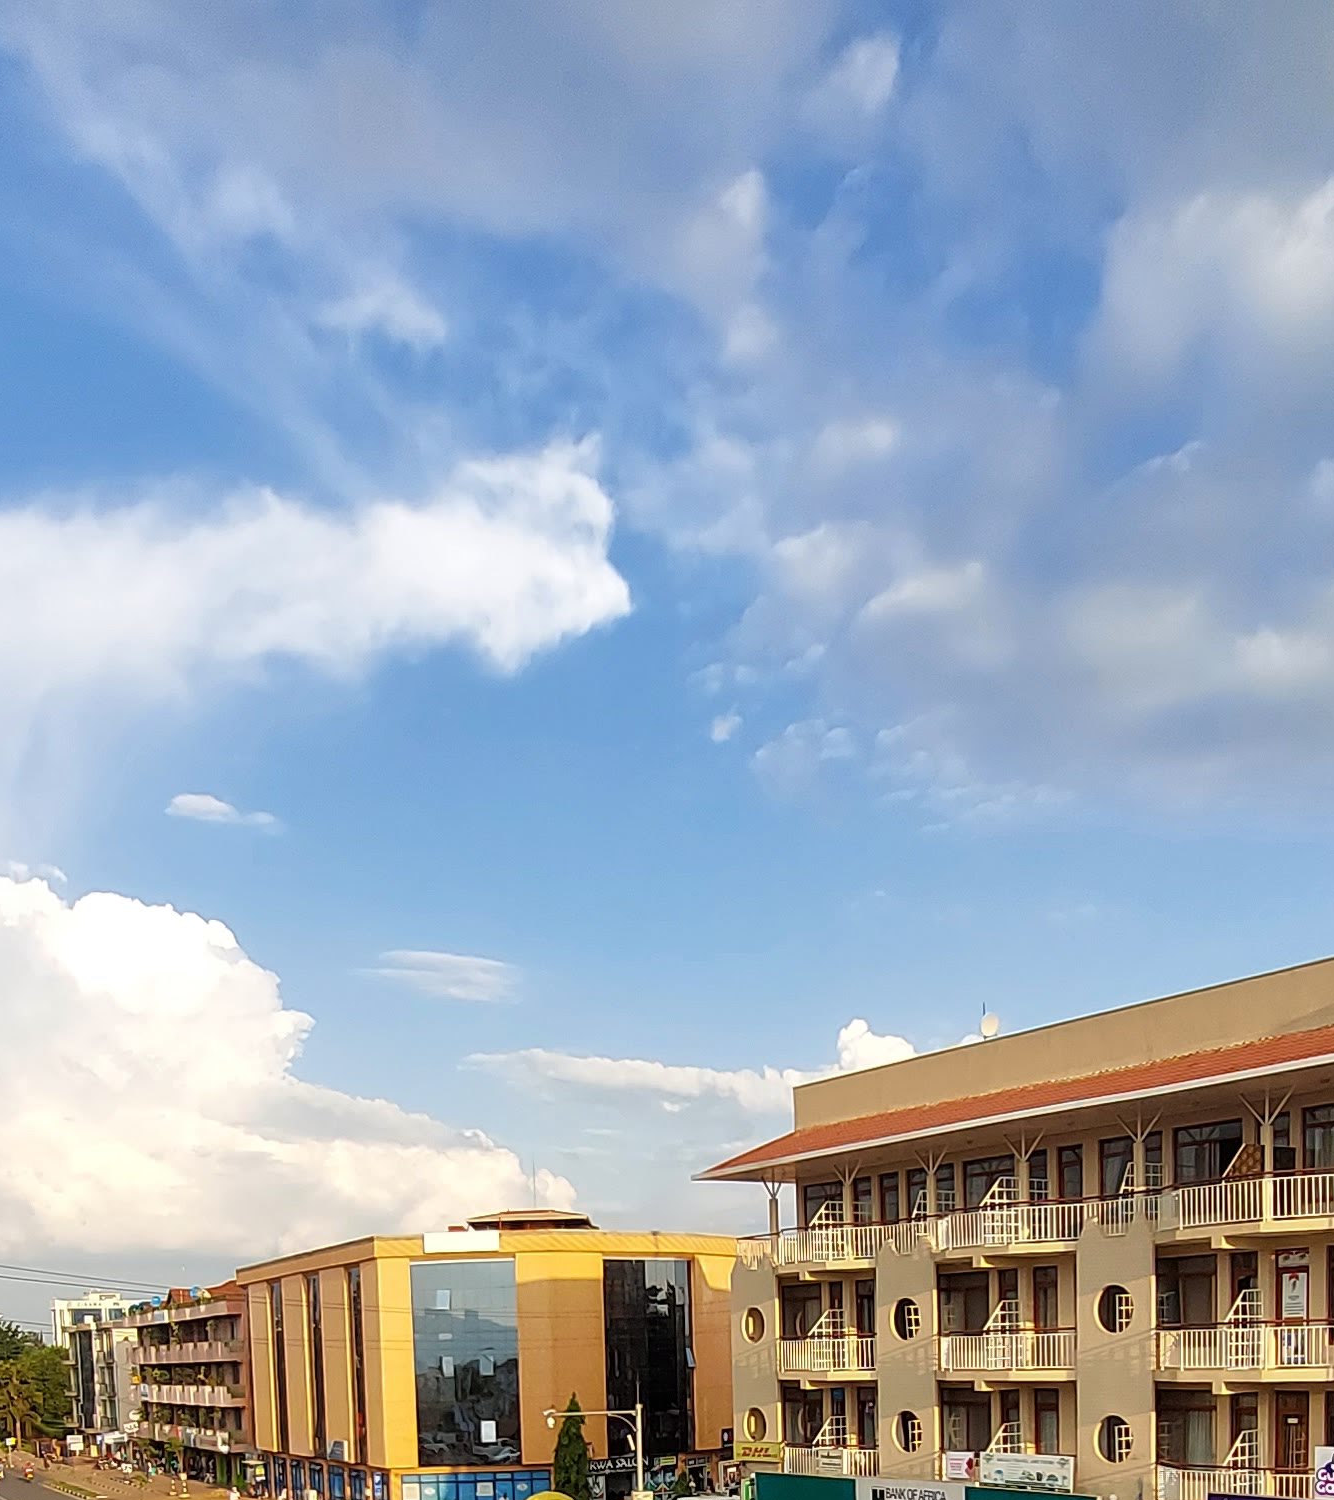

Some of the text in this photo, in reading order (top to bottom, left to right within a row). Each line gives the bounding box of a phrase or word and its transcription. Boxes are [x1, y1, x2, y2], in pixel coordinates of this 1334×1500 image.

[740, 1446, 772, 1458] DHL
[885, 1487, 907, 1500] BANK
[907, 1488, 918, 1500] OF
